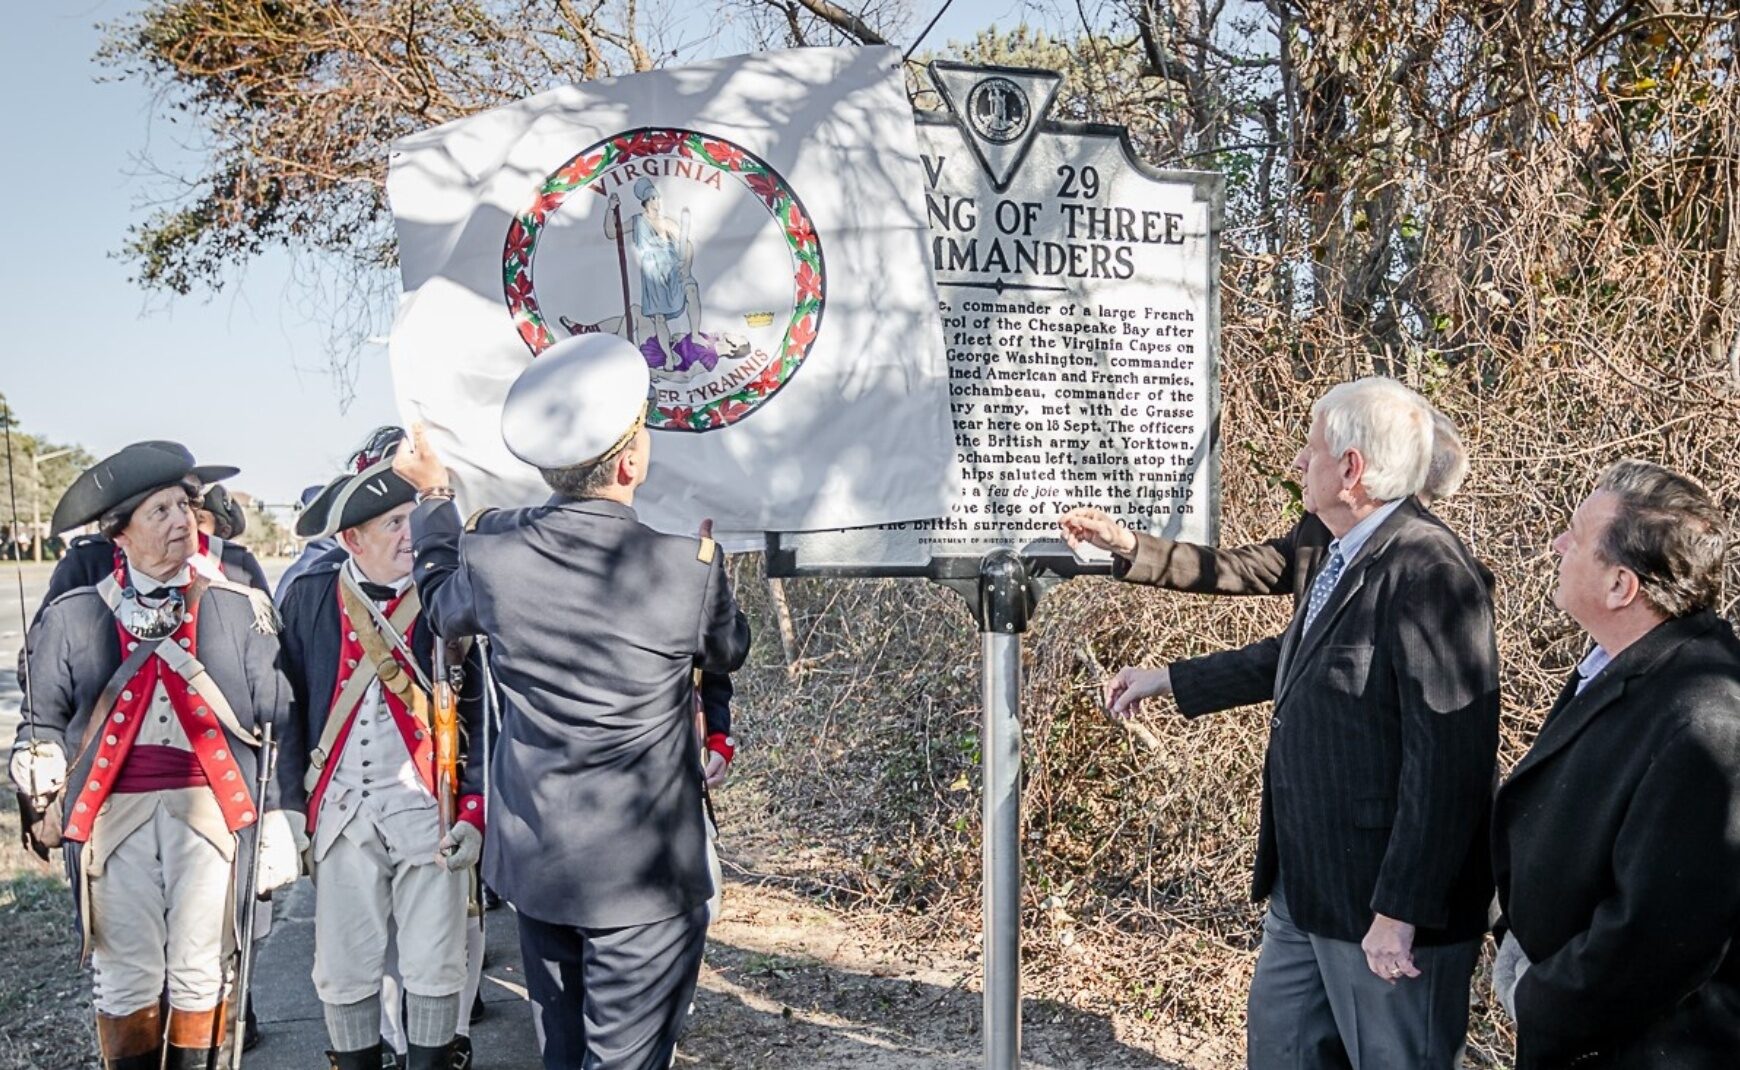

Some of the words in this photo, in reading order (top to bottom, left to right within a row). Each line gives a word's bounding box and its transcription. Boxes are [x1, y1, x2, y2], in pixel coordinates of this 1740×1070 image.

[588, 158, 722, 196] VIRGINIA
[1057, 165, 1100, 199] 29
[995, 200, 1042, 236] OF
[1060, 203, 1185, 245] THREE
[963, 301, 1051, 314] commander
[1060, 304, 1076, 315] of
[1083, 307, 1091, 316] a
[1099, 304, 1136, 321] large
[1144, 307, 1194, 321] French
[973, 317, 991, 329] of
[996, 318, 1021, 330] the
[1028, 318, 1117, 335] Chesapeake
[1123, 322, 1150, 338] Bay
[1156, 325, 1194, 338] after
[954, 333, 992, 345] fleet
[999, 335, 1024, 348] off
[1030, 335, 1056, 348] the
[1062, 336, 1123, 352] Virginia
[1130, 340, 1171, 354] Capes
[1177, 344, 1194, 354] on
[946, 348, 1000, 365] George
[1110, 357, 1194, 369] commander
[686, 349, 768, 403] TYRANNIS
[986, 367, 1057, 381] American
[1061, 371, 1086, 383] and
[1092, 371, 1139, 384] French
[1055, 387, 1141, 400] commander
[1148, 389, 1164, 401] of
[1170, 390, 1194, 402] the
[1042, 403, 1071, 415] met
[1079, 404, 1113, 417] with
[1120, 405, 1138, 417] de
[1146, 405, 1194, 418] Grasse
[987, 418, 1021, 431] here
[1025, 421, 1043, 431] on
[1047, 420, 1060, 431] 18
[1063, 420, 1101, 434] Sept.
[1107, 420, 1135, 433] The
[1140, 422, 1194, 434] officers
[955, 434, 980, 447] the
[988, 434, 1042, 448] British
[1050, 438, 1090, 450] army
[1099, 438, 1114, 449] at
[1121, 437, 1194, 450] Yorktown.
[1045, 452, 1077, 465] left,
[1082, 452, 1128, 465] sailors
[1134, 454, 1165, 467] atop
[1170, 455, 1194, 466] the
[1000, 468, 1055, 480] saluted
[1060, 469, 1097, 481] them
[1102, 470, 1134, 481] with
[1139, 470, 1194, 485] running
[973, 487, 981, 497] a
[987, 484, 1009, 497] feu
[1013, 485, 1029, 497] de
[1031, 485, 1060, 500] joie
[1065, 485, 1102, 497] while
[1107, 486, 1131, 498] the
[1136, 486, 1194, 500] flagship
[984, 501, 1022, 517] siege
[1029, 501, 1046, 514] of
[1127, 502, 1171, 517] began
[1177, 504, 1194, 514] on
[914, 517, 968, 530] British
